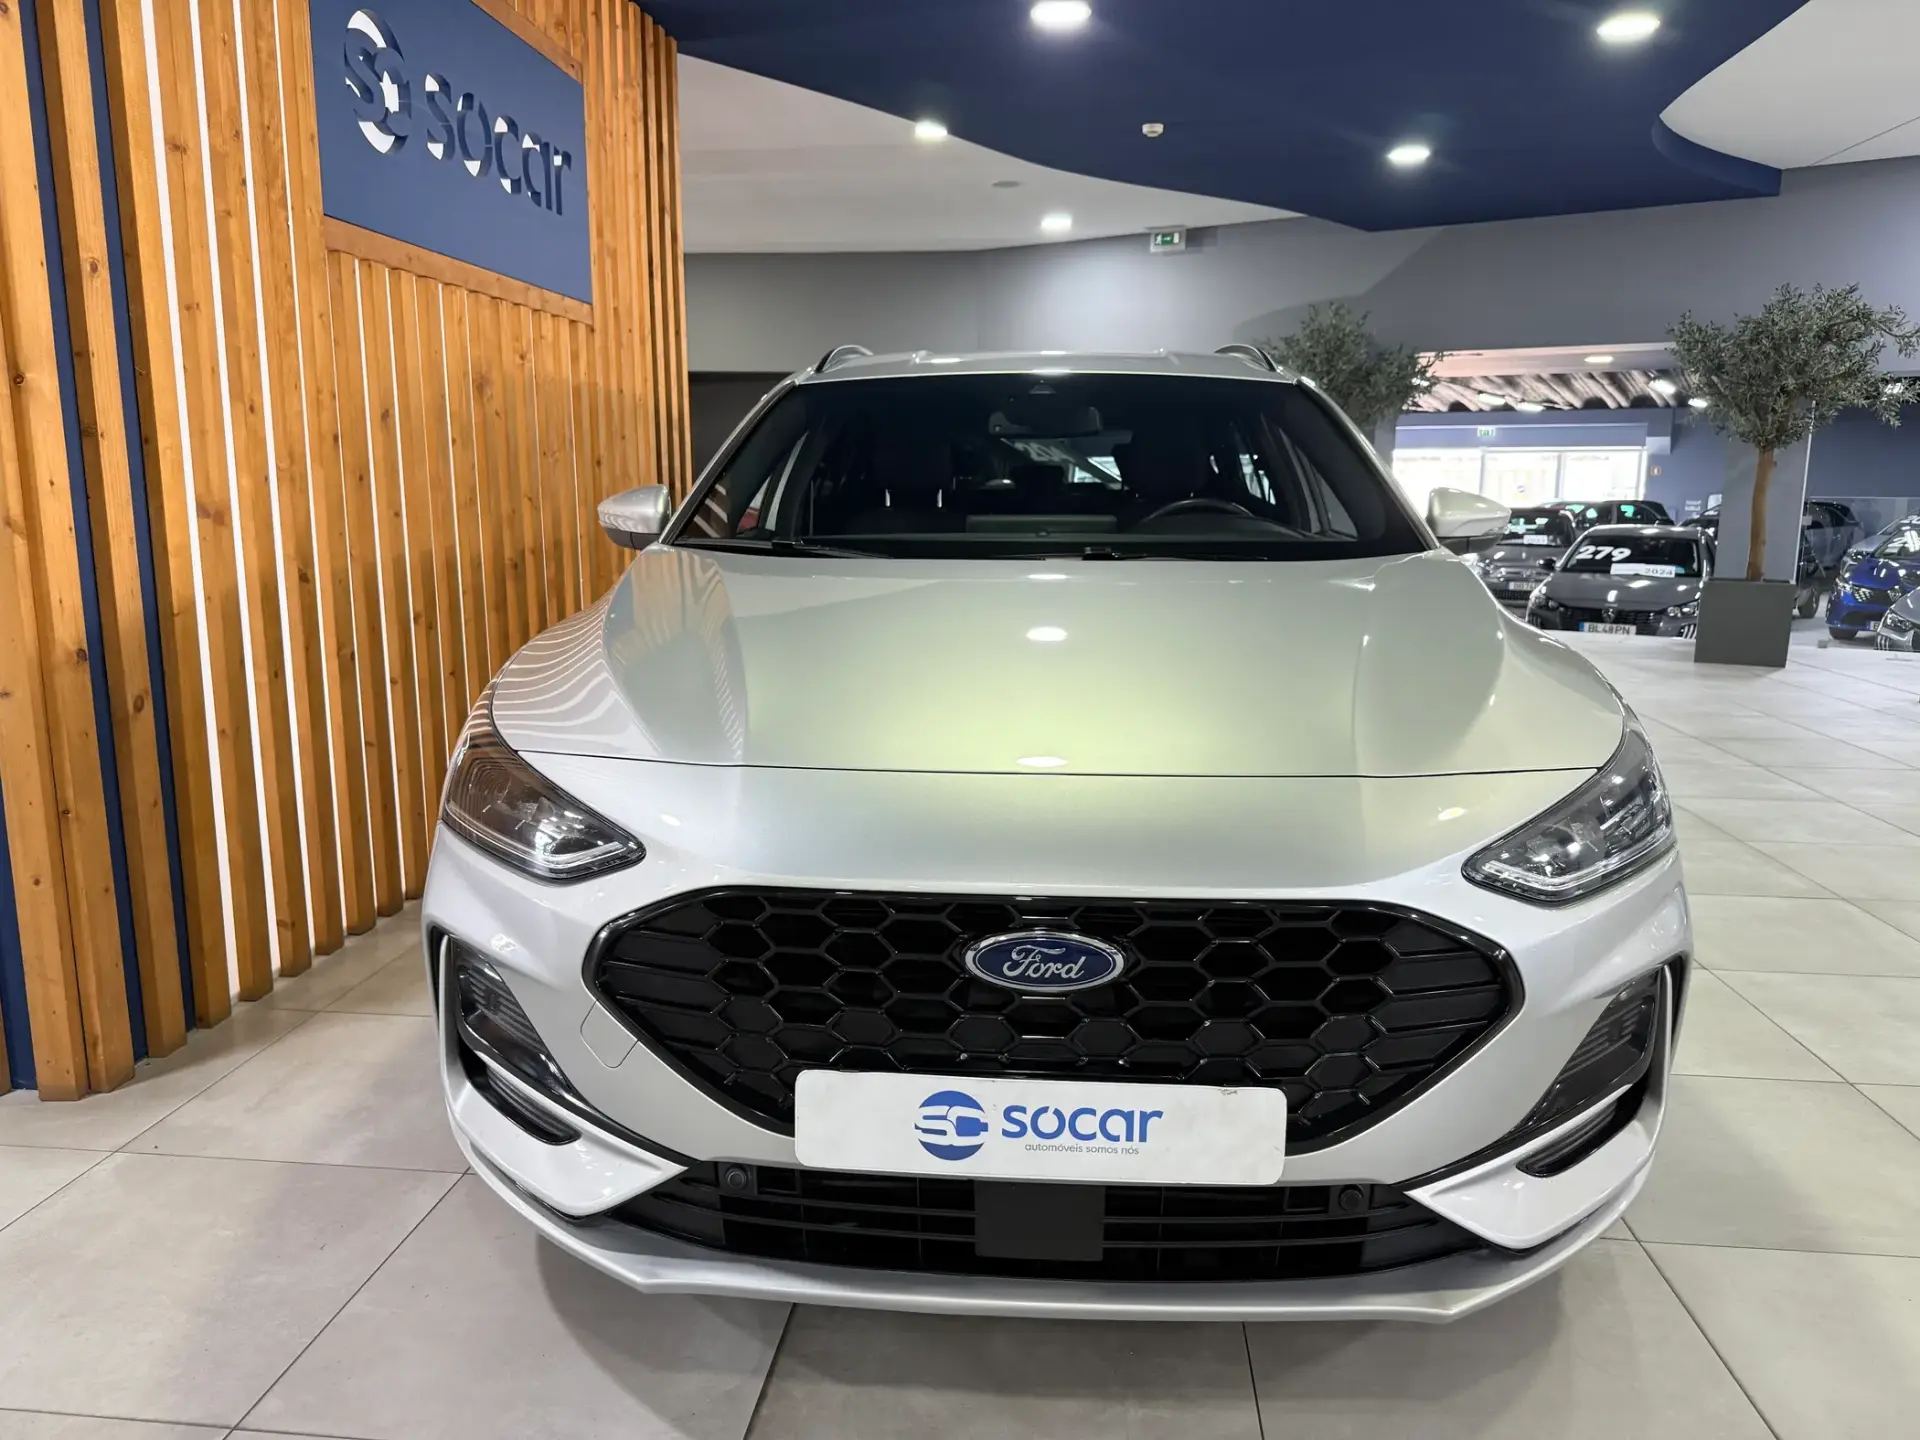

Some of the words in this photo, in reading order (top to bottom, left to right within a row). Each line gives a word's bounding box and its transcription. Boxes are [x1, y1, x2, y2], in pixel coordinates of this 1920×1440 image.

[425, 73, 571, 216] socar
[1575, 545, 1632, 561] 279
[1644, 567, 1673, 576] 2024
[1002, 944, 1087, 979] Ford
[1001, 1105, 1164, 1143] socar
[1024, 1142, 1083, 1153] automóveis
[1085, 1145, 1119, 1155] somos
[1121, 1145, 1139, 1156] nós
